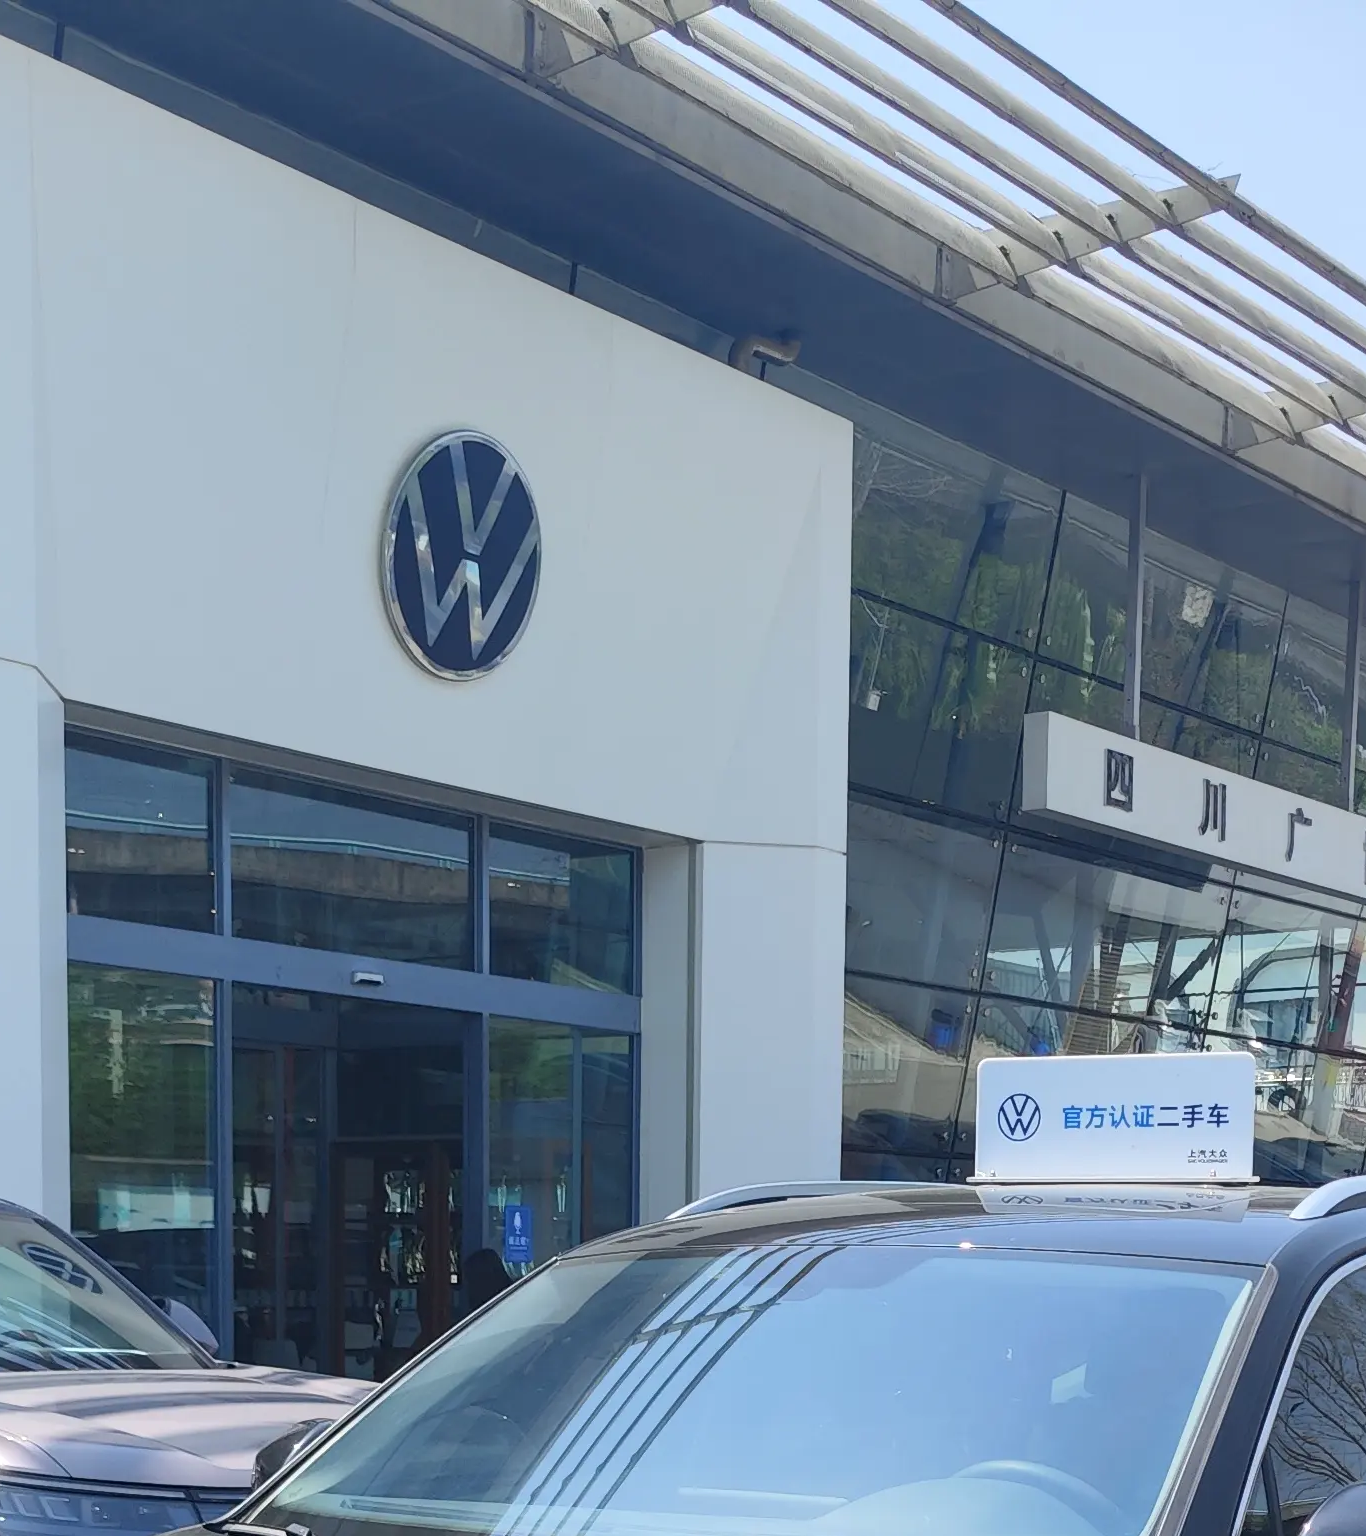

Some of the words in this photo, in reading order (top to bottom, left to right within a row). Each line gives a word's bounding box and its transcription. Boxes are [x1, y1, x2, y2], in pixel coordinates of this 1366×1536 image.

[381, 429, 542, 682] VW
[1062, 1103, 1230, 1130] 官方认证二手车
[1187, 1149, 1228, 1158] 上汽大众
